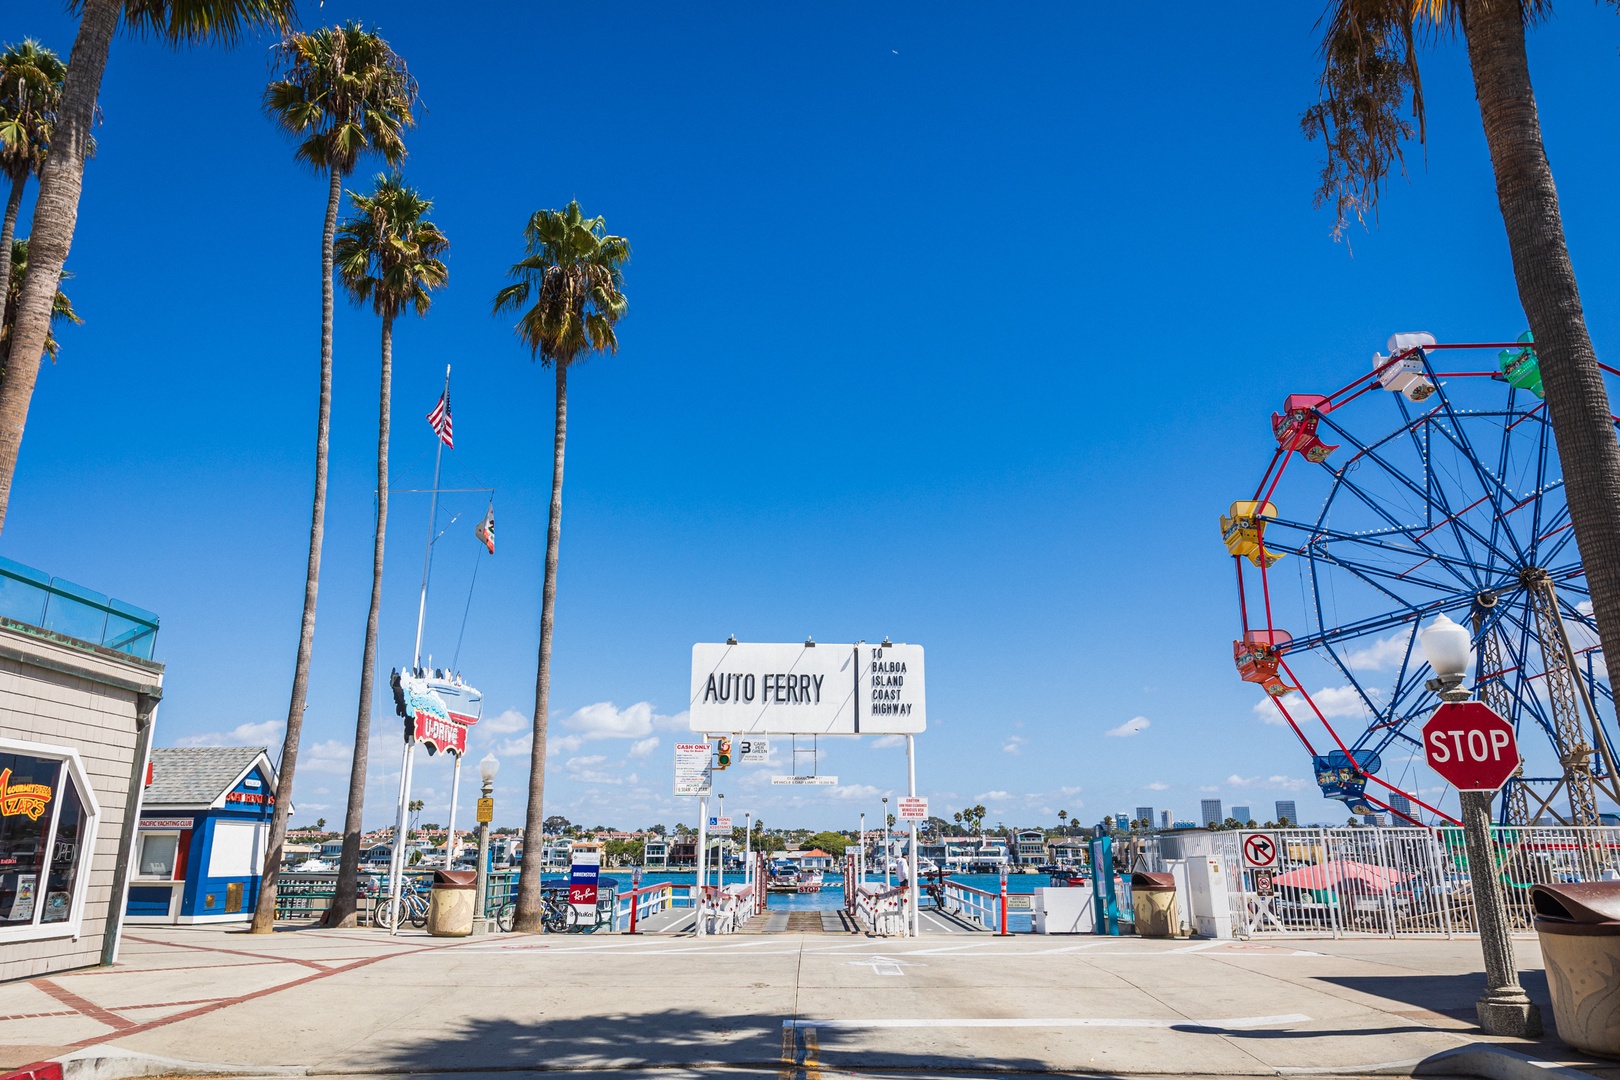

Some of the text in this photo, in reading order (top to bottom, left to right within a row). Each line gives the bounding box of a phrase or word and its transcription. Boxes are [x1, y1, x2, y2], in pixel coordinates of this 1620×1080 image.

[872, 648, 883, 659] TO
[872, 661, 907, 673] BALBOA
[872, 675, 904, 687] ISLAND
[704, 673, 824, 704] AUTO FERRY
[872, 689, 901, 700] COAST
[872, 703, 912, 714] HIGHWAY
[425, 718, 459, 745] U-DRIVE
[741, 741, 751, 754] 3
[1430, 729, 1510, 763] STOP
[7, 784, 35, 794] GOURMET
[53, 842, 79, 861] OPEN
[571, 887, 595, 901] Ray-Ban
